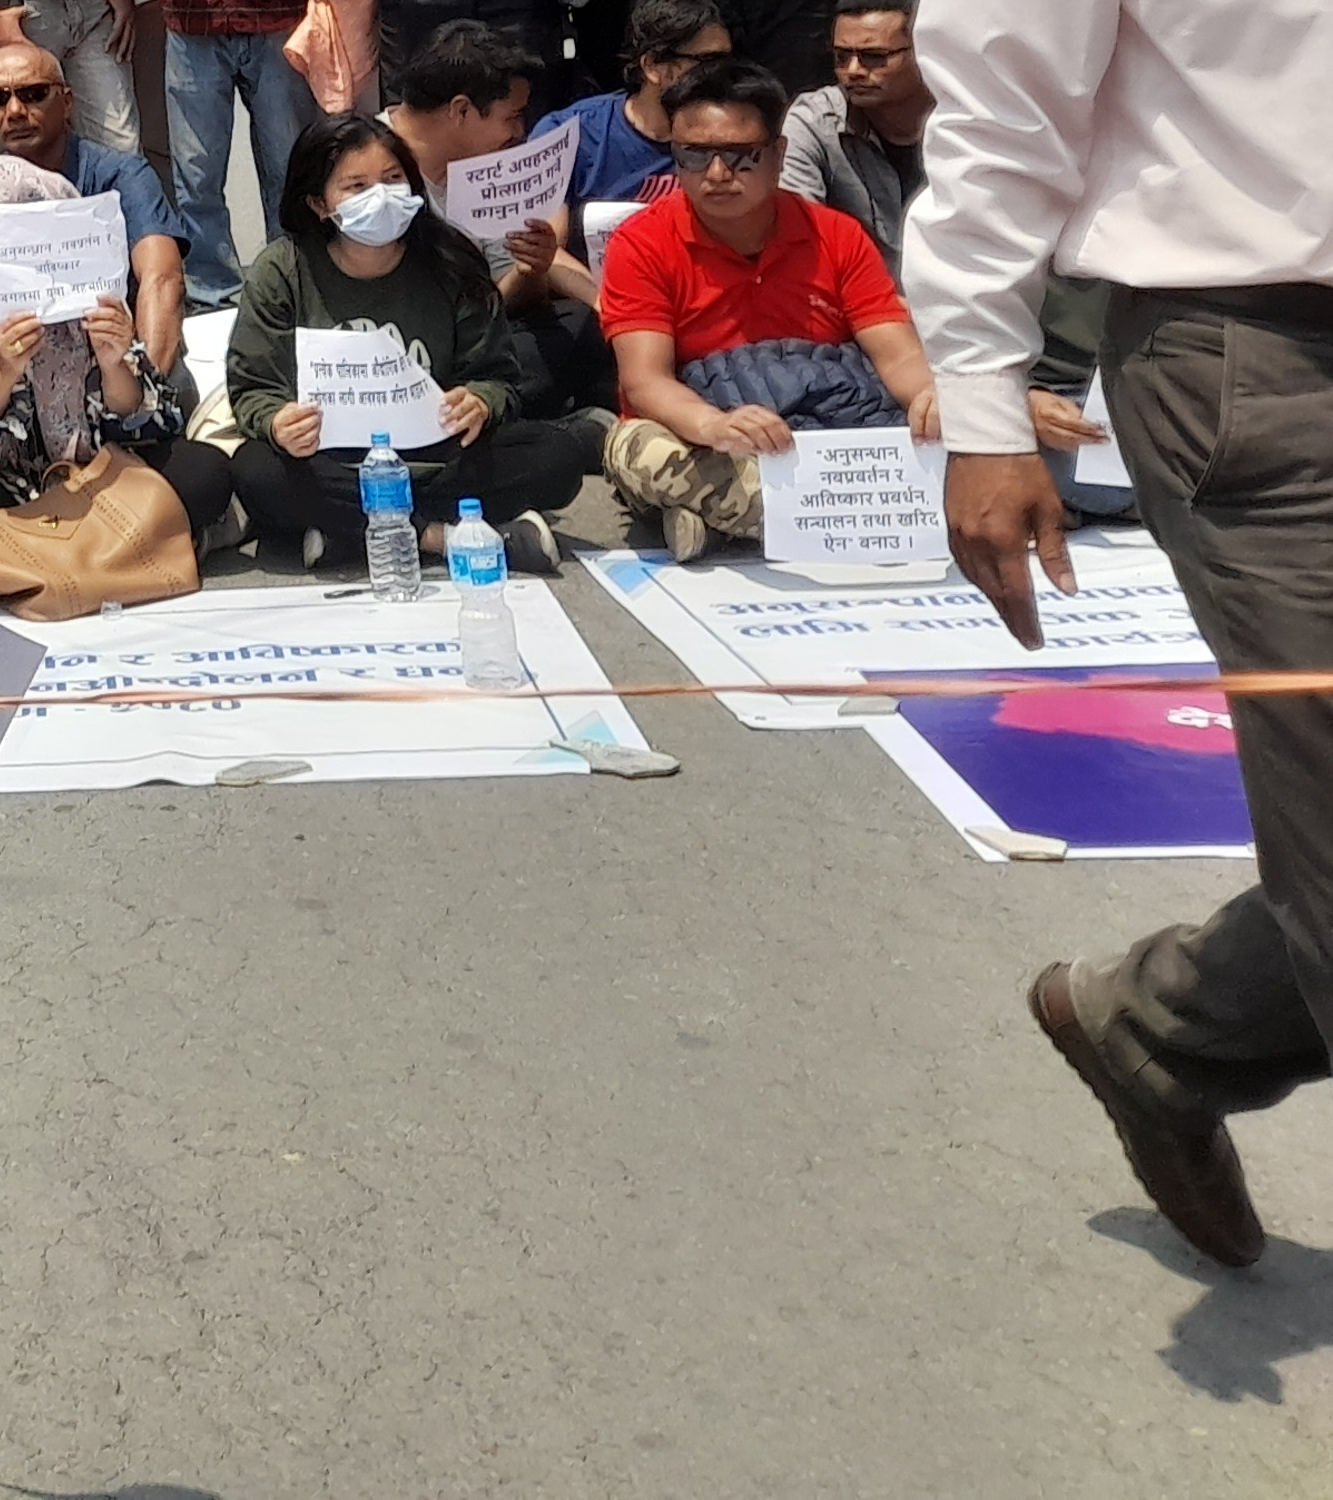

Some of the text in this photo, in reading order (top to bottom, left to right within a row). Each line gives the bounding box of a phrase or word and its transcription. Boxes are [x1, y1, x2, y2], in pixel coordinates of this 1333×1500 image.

[465, 159, 504, 185] स्टार्ट
[481, 171, 544, 201] प्रोत्साहन
[470, 200, 520, 221] कानुन
[819, 464, 904, 485] नवप्रवर्तन र
[800, 488, 873, 509] आविष्कार
[861, 514, 892, 528] तथा
[897, 507, 940, 528] खरिद
[172, 637, 462, 664] आविष्कारक
